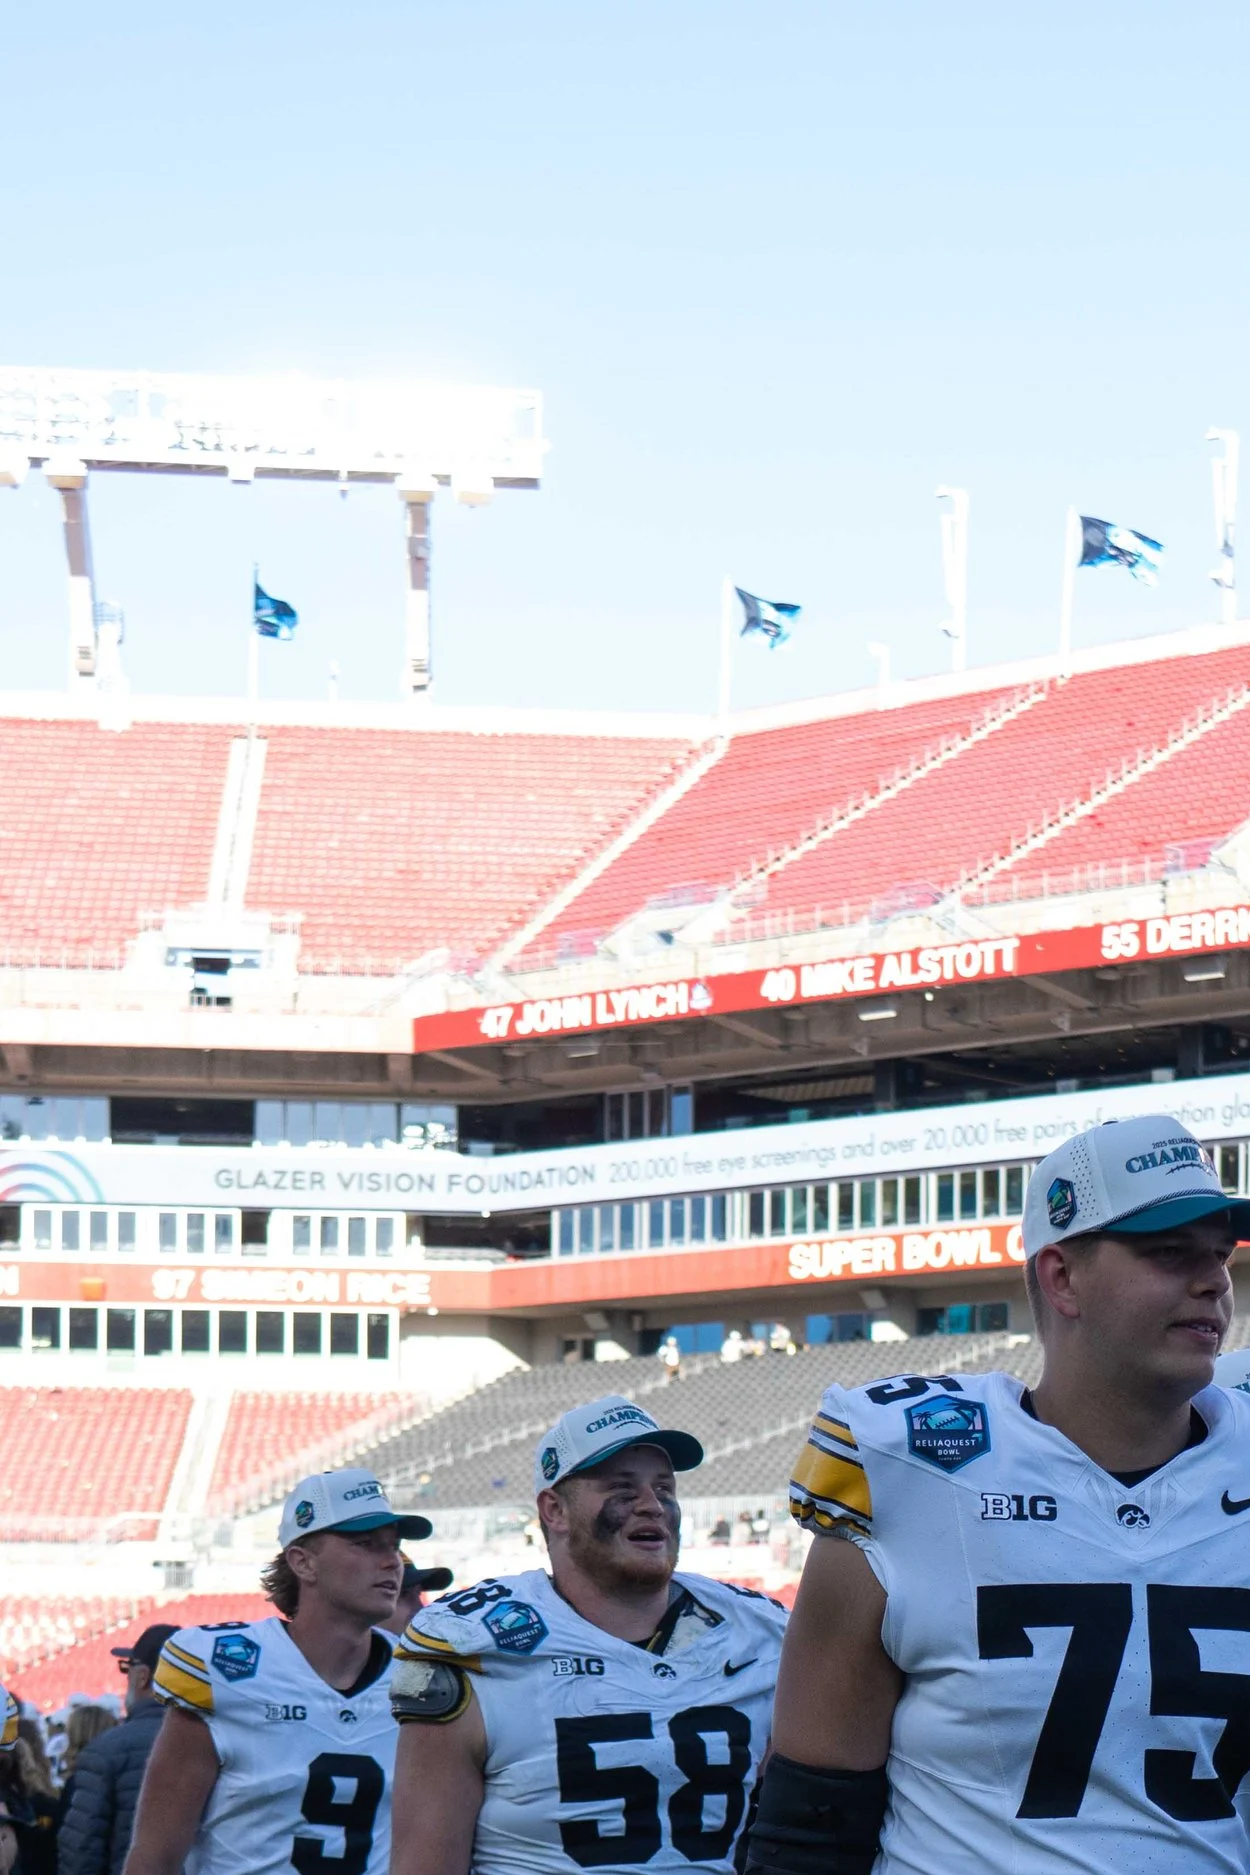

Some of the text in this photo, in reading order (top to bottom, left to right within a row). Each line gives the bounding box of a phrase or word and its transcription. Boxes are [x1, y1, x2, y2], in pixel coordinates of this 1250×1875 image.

[760, 937, 1020, 1001] 40 MIKE ALSTOTT
[1101, 922, 1139, 959] 55
[479, 981, 689, 1038] 47 JOHN LYNCH
[214, 1168, 326, 1191] GLAZER
[337, 1172, 435, 1193] VISION
[447, 1163, 596, 1194] FOUNDATION
[683, 1152, 713, 1176] free
[718, 1155, 746, 1177] eye
[752, 1142, 836, 1168] screenings
[843, 1132, 875, 1159] and
[880, 1137, 917, 1156] over
[994, 1118, 1028, 1144] free
[1032, 1115, 1078, 1146] pairs
[788, 1236, 896, 1279] SUPER
[903, 1229, 1002, 1269] BOWL
[152, 1268, 431, 1304] 97 SIMEON RICE
[555, 1704, 752, 1867] 58
